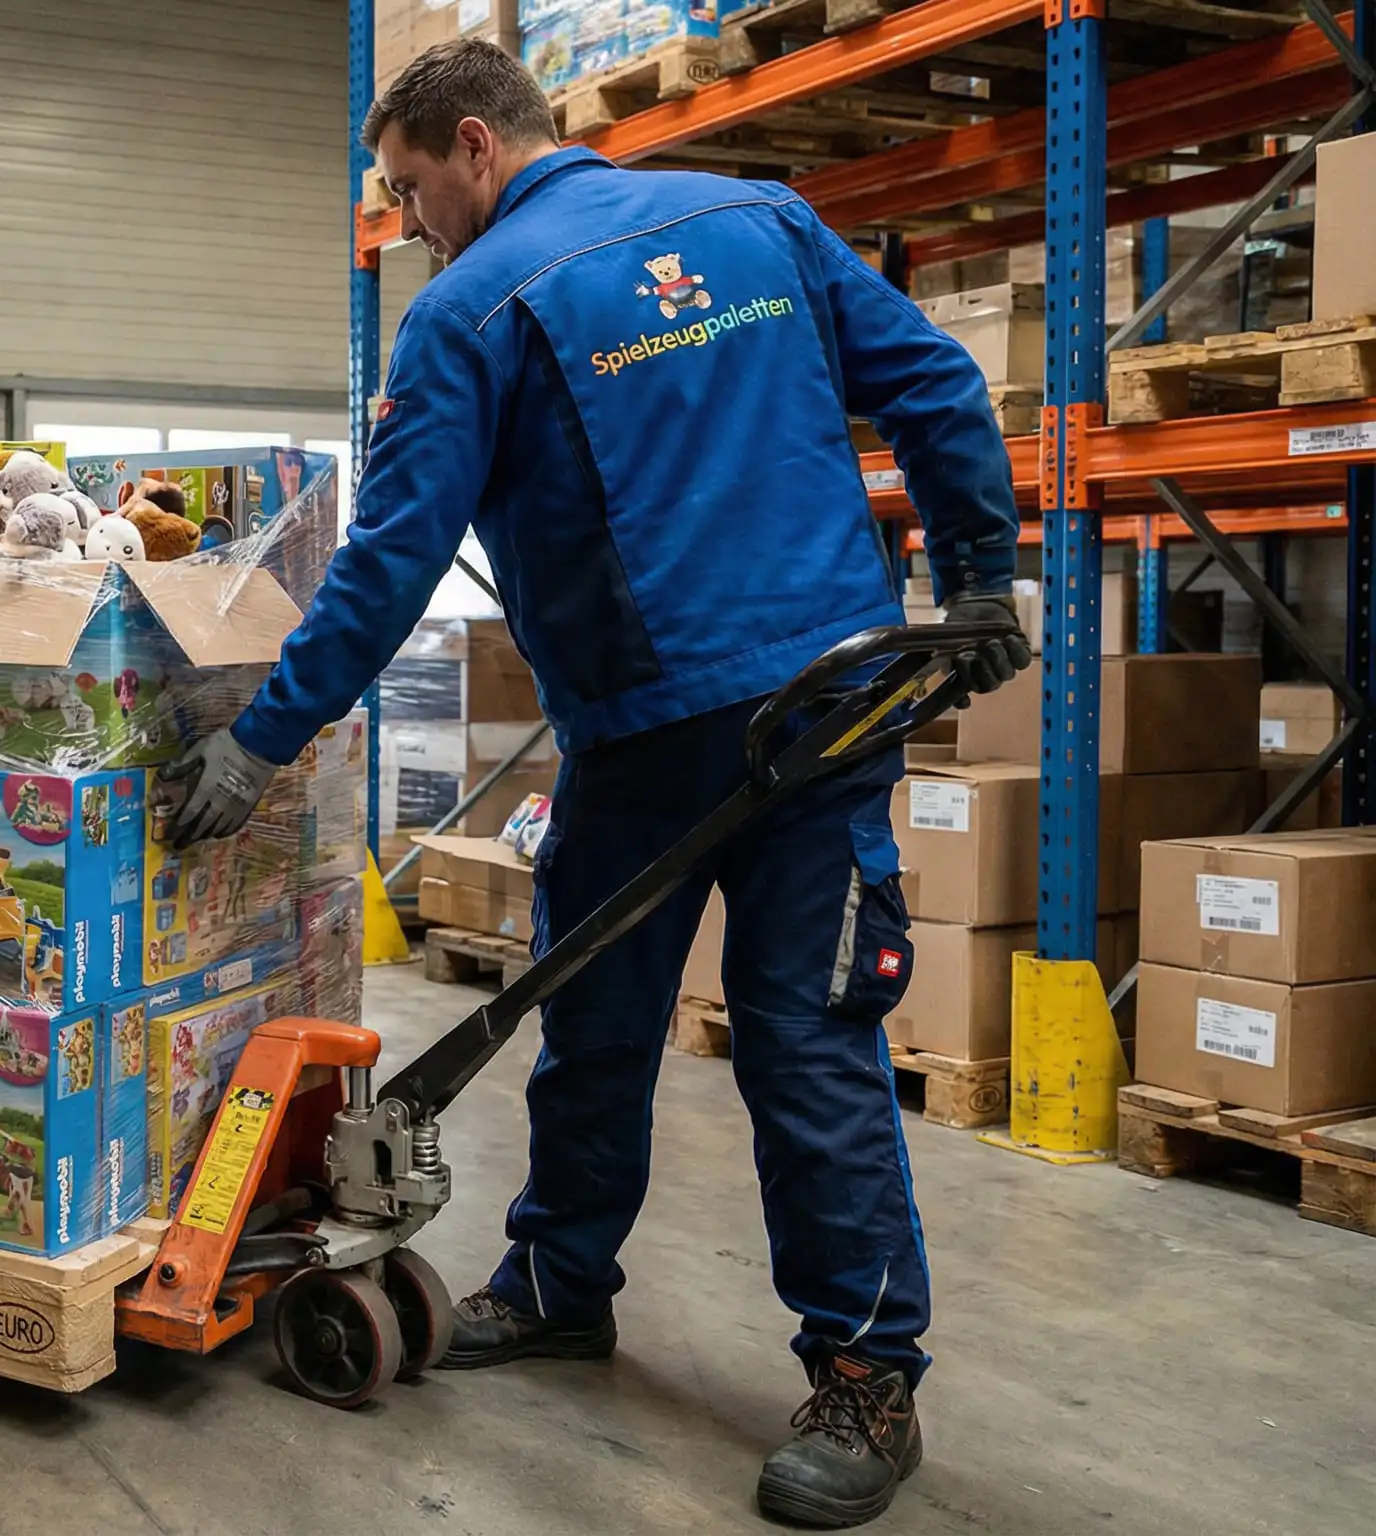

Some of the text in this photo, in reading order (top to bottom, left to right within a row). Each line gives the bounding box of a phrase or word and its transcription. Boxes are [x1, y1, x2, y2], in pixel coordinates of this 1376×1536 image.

[591, 296, 793, 376] Spielzeugpaletten
[74, 921, 86, 1003] playmobil
[56, 1156, 70, 1244] playmobil
